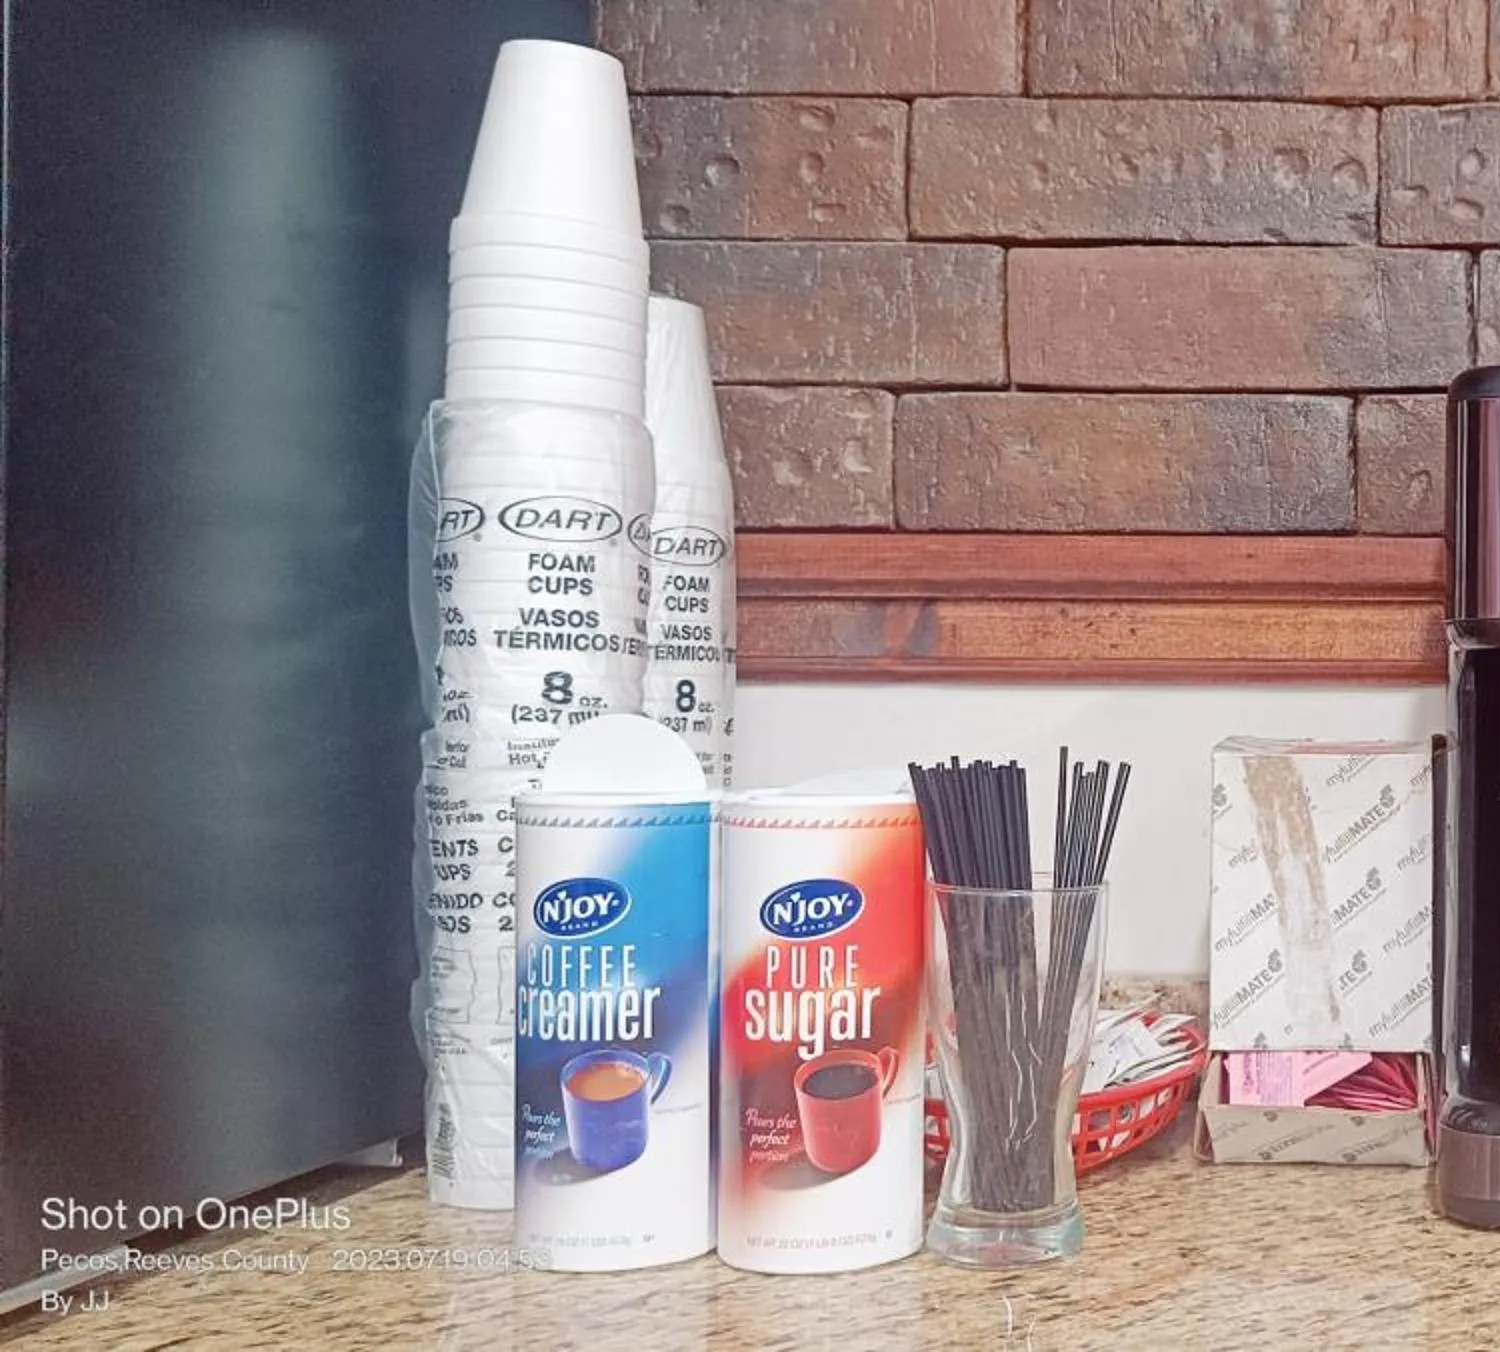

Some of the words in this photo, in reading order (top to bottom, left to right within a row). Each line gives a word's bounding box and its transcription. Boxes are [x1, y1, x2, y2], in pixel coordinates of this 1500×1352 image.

[515, 508, 612, 531] DART
[654, 537, 718, 556] DART
[528, 554, 595, 572] FOAM
[527, 576, 593, 595] CUPS
[665, 595, 709, 613] CUPS
[519, 608, 600, 627] VASOS
[494, 626, 620, 652] TÉRMICOS
[661, 624, 712, 641] VASOS
[541, 671, 573, 704] 8
[676, 679, 696, 713] 8
[511, 704, 563, 725] (237
[527, 944, 636, 988] COFFEE
[766, 944, 860, 989] PURE
[518, 984, 661, 1041] creamer
[745, 984, 882, 1060] sugar
[525, 1129, 555, 1144] perfect
[749, 1130, 790, 1147] perfect
